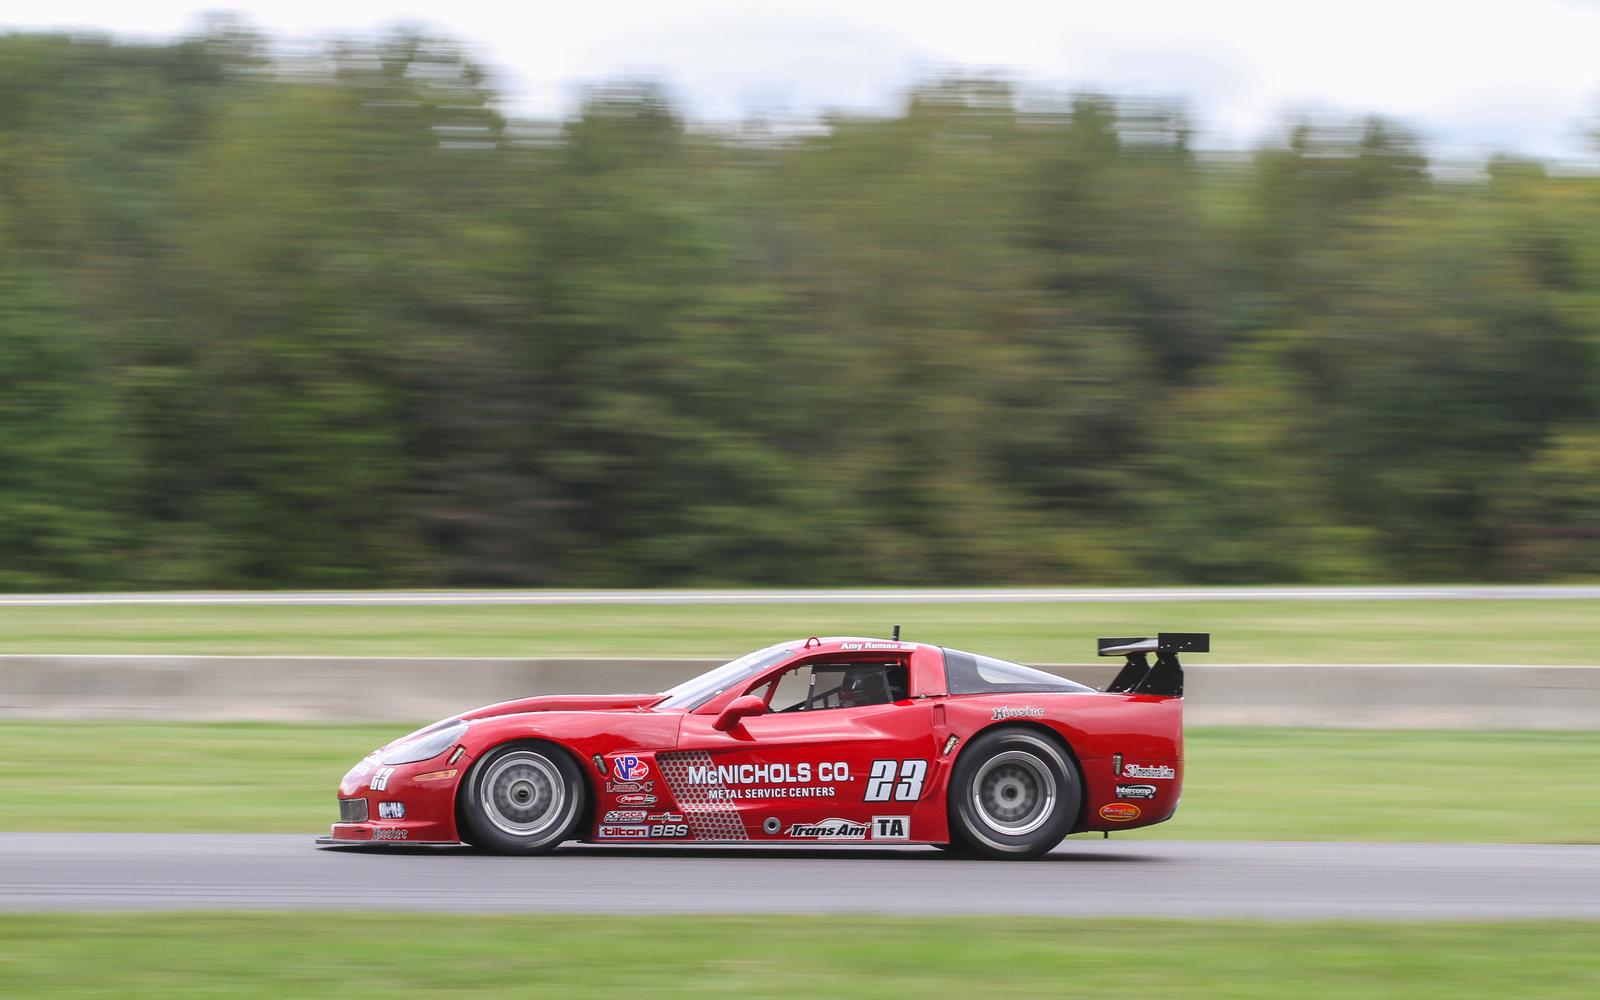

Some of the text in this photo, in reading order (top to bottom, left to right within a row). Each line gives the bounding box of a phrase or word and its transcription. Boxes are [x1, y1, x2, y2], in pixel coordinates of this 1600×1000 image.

[841, 642, 863, 651] Amy
[615, 755, 638, 780] VP
[688, 761, 855, 785] McNICHOLS CO.
[864, 758, 928, 802] 23
[708, 786, 835, 799] METAL SERVICE CENTERS
[1115, 785, 1152, 796] Intercomp
[602, 826, 646, 836] tilton
[650, 824, 689, 837] BBS
[791, 823, 866, 836] Trans Am
[877, 819, 905, 836] TA
